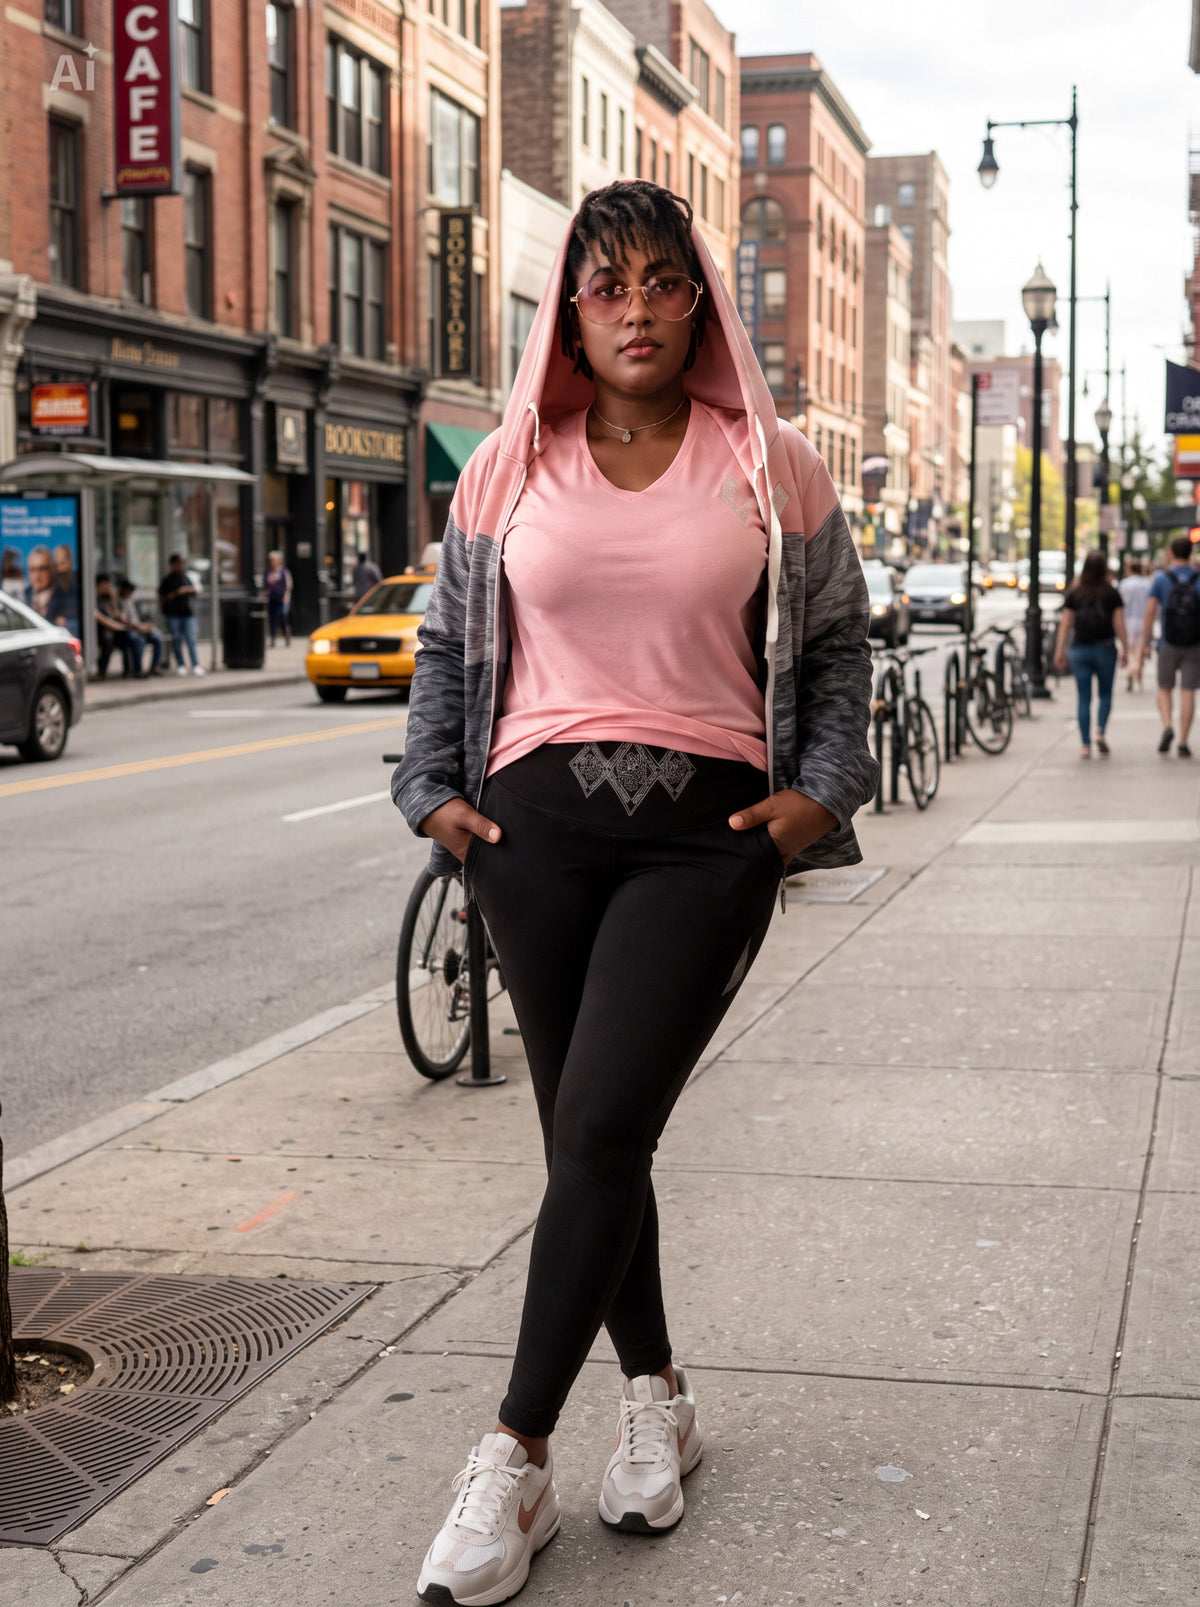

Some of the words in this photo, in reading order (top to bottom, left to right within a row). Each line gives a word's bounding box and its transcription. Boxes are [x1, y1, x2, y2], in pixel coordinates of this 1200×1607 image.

[124, 5, 162, 162] CAFE
[446, 217, 466, 371] BOOKSTORE
[325, 423, 404, 462] BOOKSTORE
